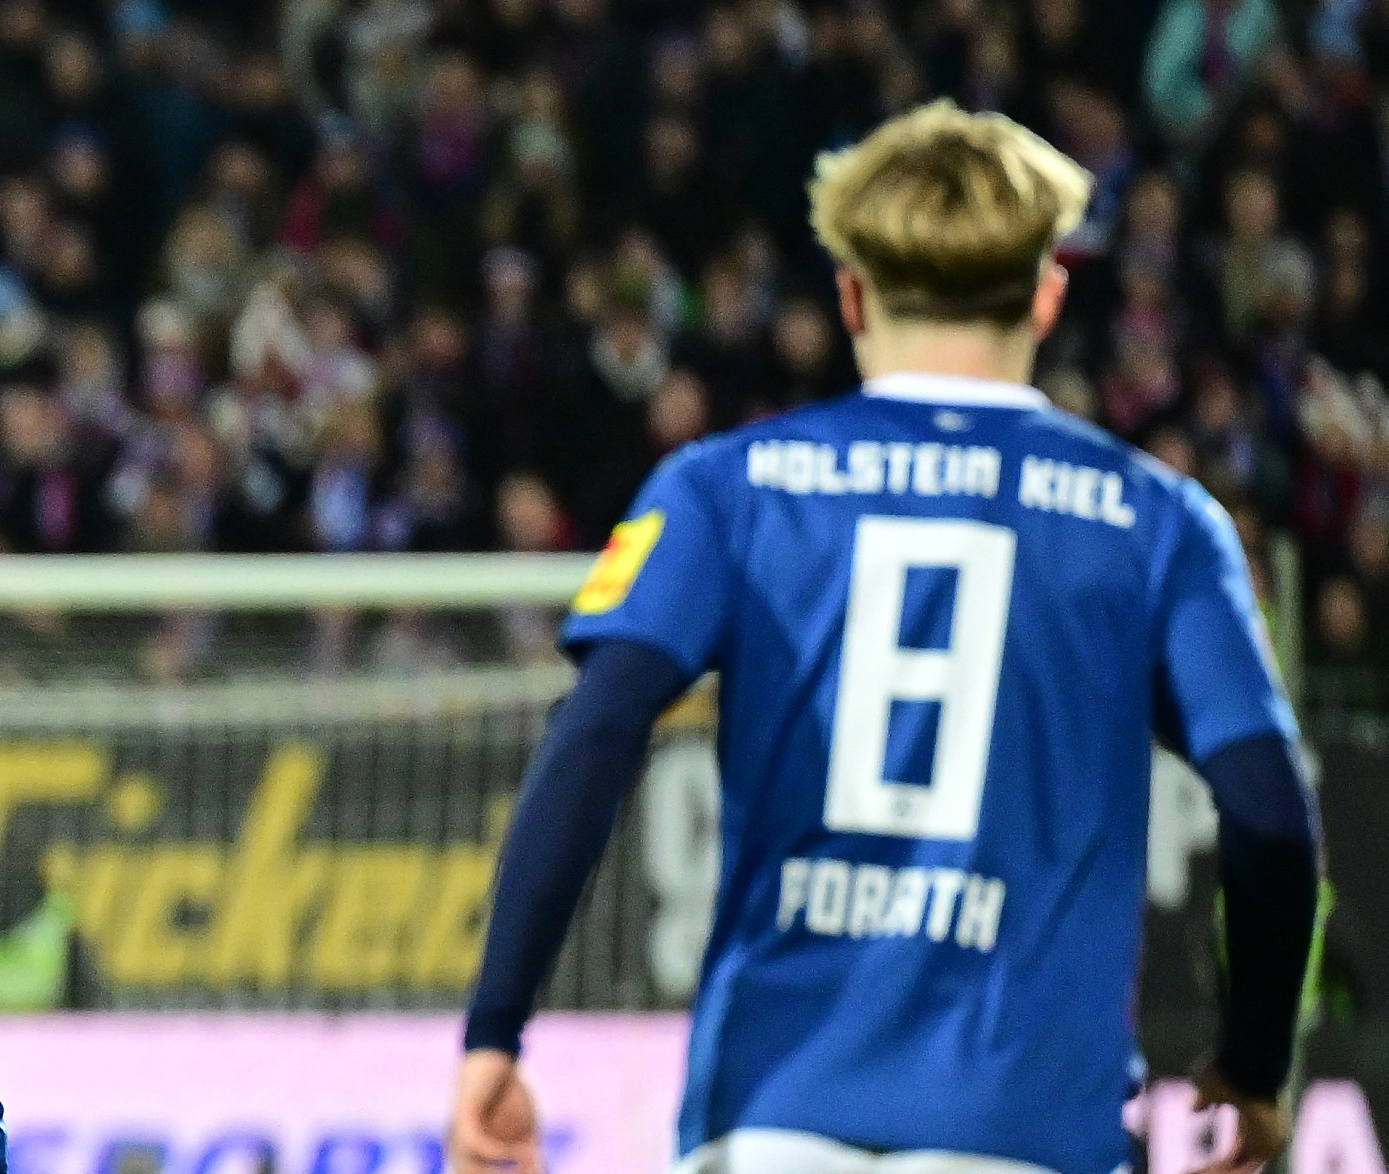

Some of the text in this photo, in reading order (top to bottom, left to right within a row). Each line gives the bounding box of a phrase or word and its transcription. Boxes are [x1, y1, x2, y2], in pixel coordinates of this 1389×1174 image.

[747, 440, 1136, 528] HOLSTEIN KIEL
[824, 514, 1017, 842] 8
